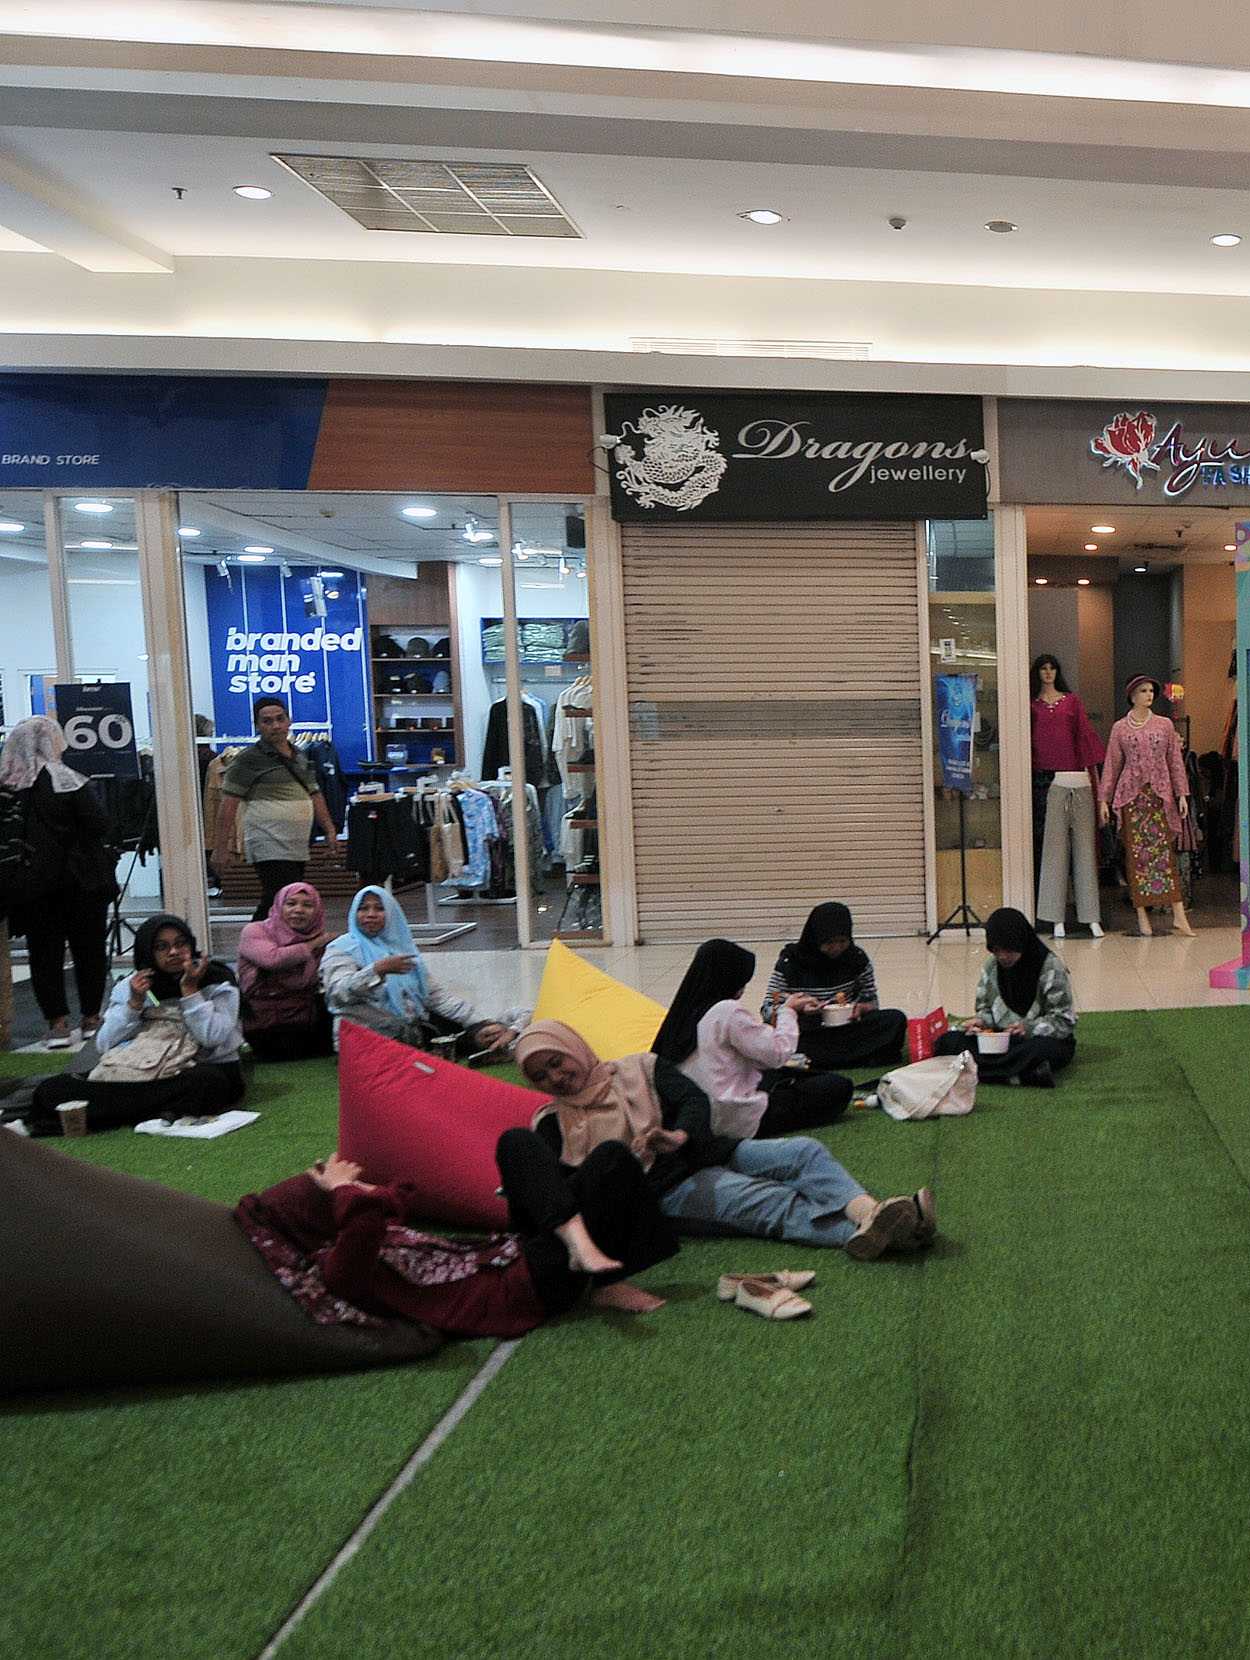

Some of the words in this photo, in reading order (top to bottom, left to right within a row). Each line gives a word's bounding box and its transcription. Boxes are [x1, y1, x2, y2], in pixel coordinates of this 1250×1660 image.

[1, 454, 51, 466] BRAND
[56, 454, 101, 466] STORE
[731, 418, 974, 494] Dragons
[869, 464, 967, 485] jewellery
[226, 627, 363, 651] branded
[227, 653, 301, 672] man
[228, 672, 316, 693] store
[64, 713, 133, 750] 60
